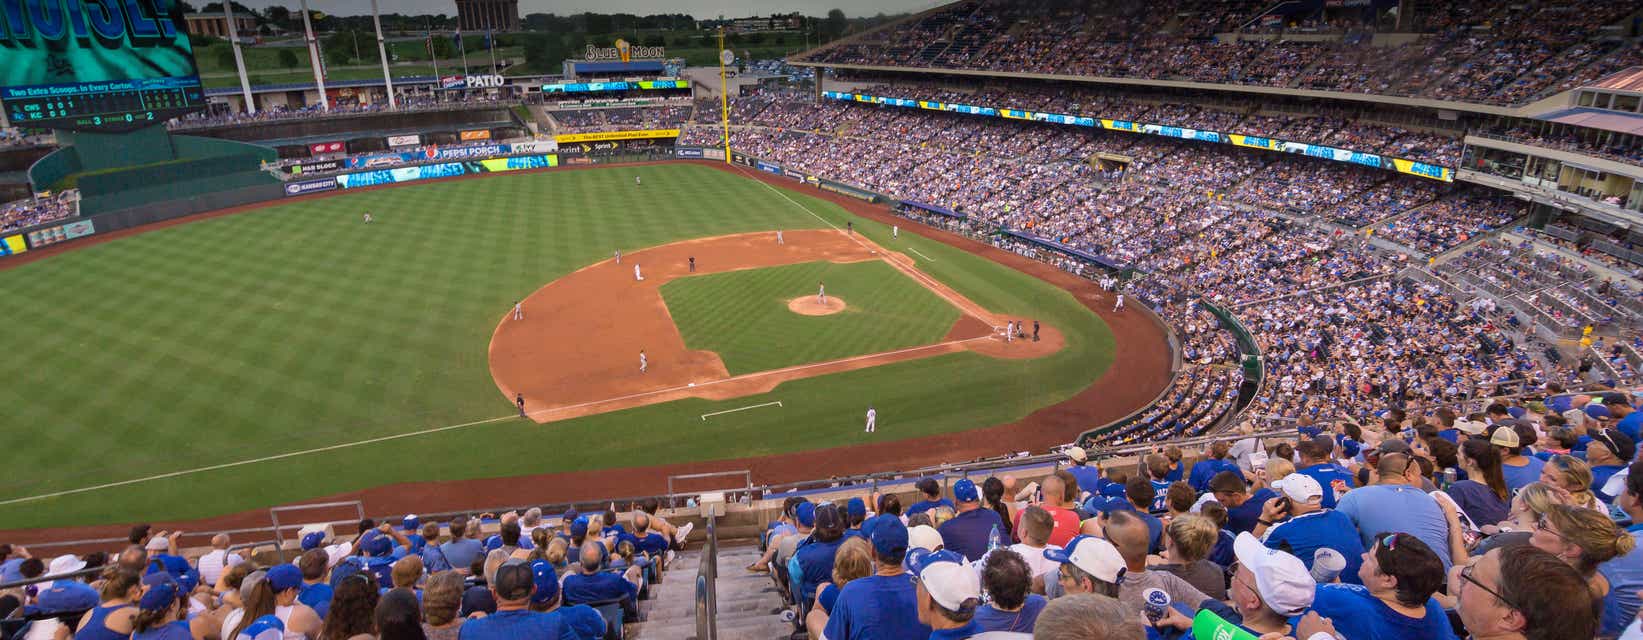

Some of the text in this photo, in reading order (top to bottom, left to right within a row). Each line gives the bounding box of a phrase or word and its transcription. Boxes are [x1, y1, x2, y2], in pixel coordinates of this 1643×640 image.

[584, 44, 664, 62] BLUE MOON
[467, 75, 504, 88] PATIO
[89, 84, 109, 92] Every
[31, 111, 43, 119] KC
[94, 116, 101, 125] 3
[126, 114, 132, 122] 0
[146, 111, 153, 120] 2
[443, 146, 500, 158] PEPSI PORCH
